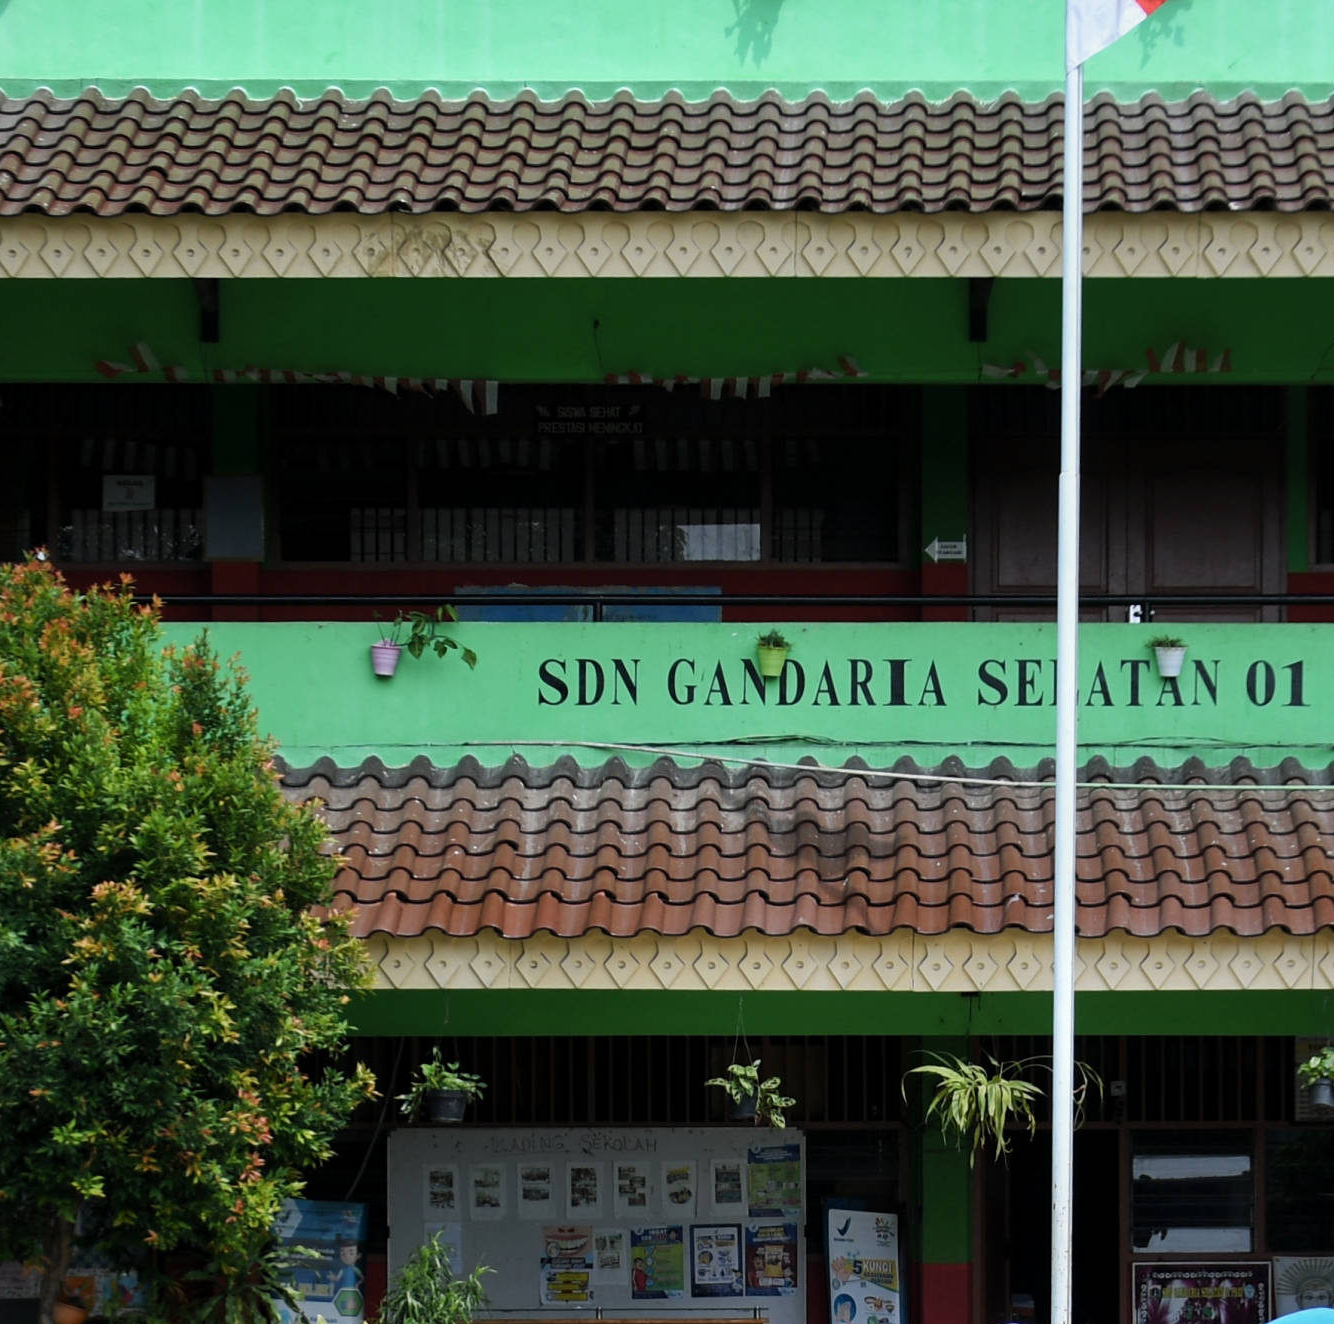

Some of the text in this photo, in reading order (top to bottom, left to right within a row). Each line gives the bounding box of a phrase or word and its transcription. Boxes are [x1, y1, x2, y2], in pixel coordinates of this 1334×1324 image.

[538, 658, 640, 706] SDN
[667, 658, 946, 706] GANDARIA
[1247, 658, 1309, 707] 01
[578, 1135, 657, 1153] SEKOLAH
[853, 1260, 863, 1275] 5
